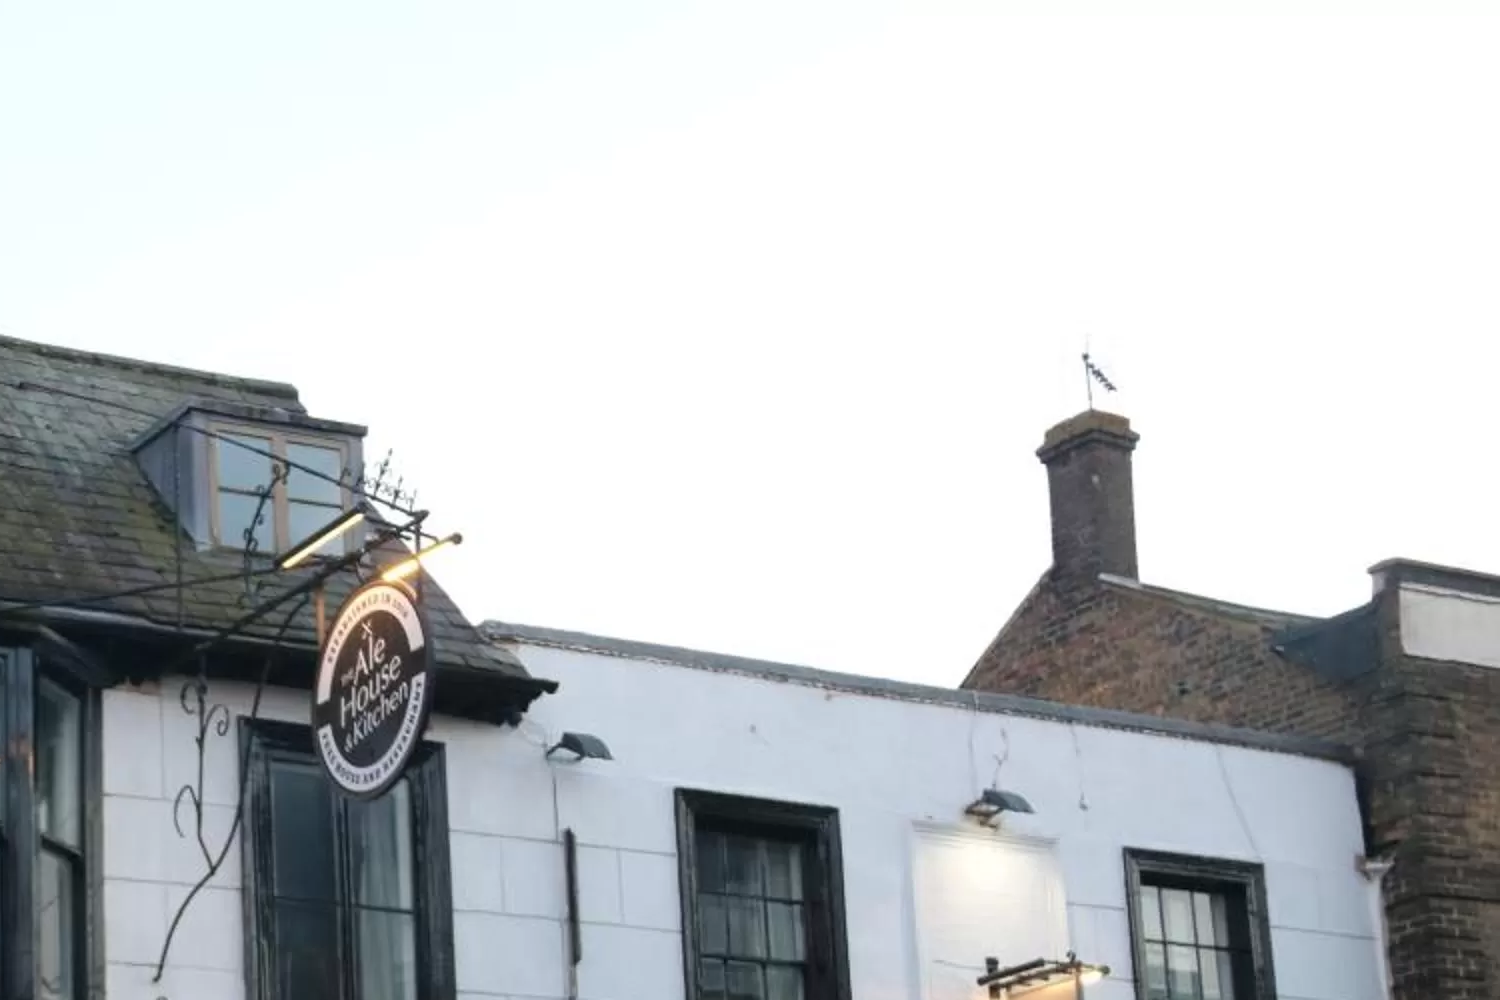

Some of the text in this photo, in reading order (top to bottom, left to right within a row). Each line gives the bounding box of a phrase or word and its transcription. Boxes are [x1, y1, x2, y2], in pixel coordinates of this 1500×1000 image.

[340, 655, 402, 729] House
[353, 632, 386, 687] Ale
[353, 681, 409, 747] Kitchen
